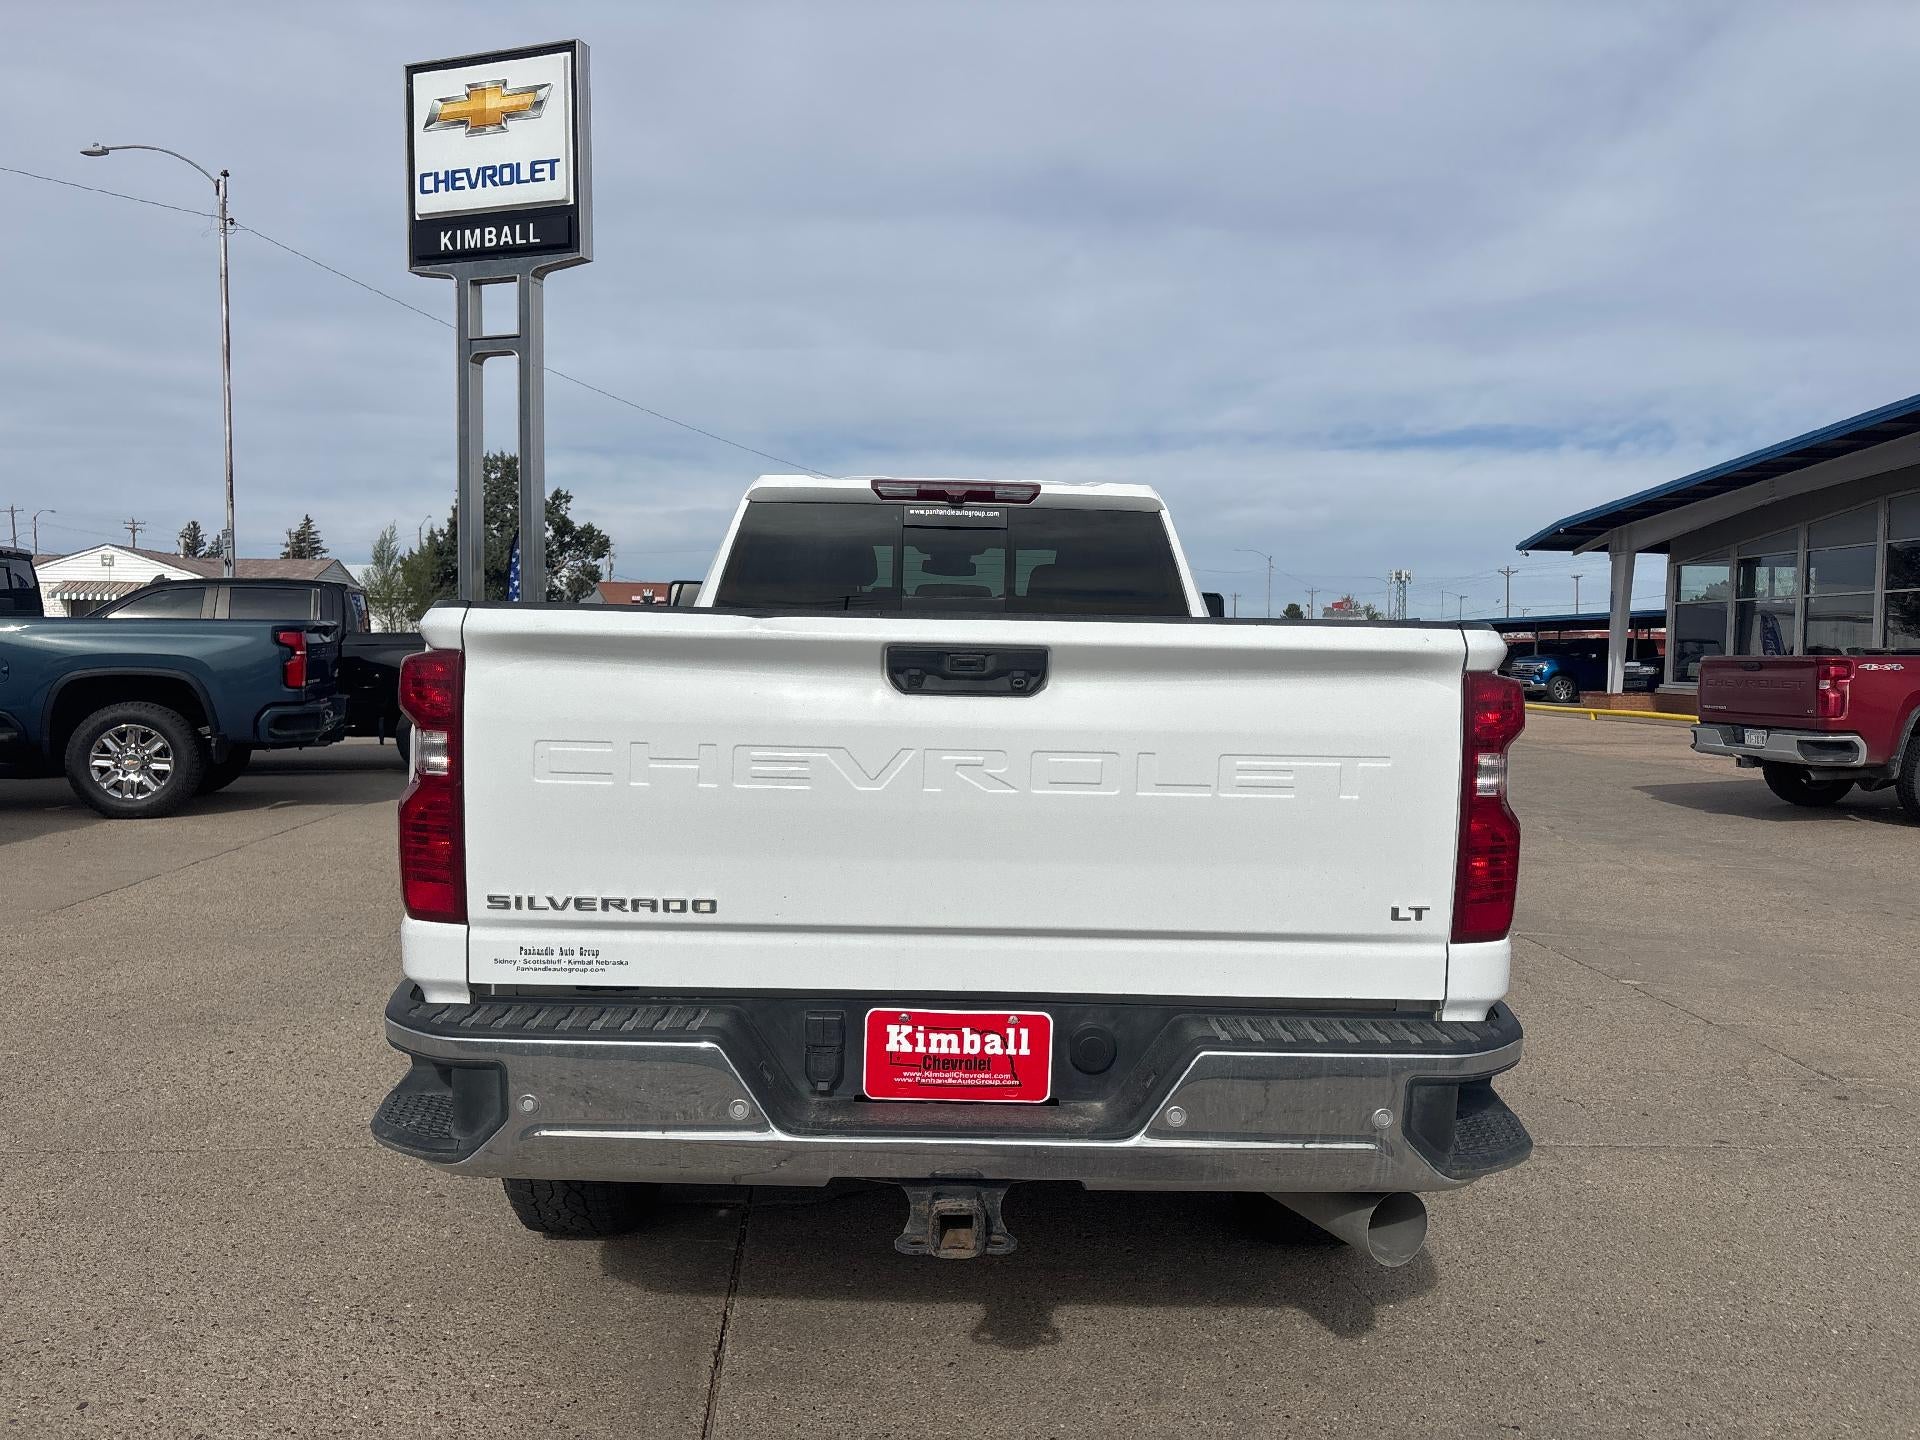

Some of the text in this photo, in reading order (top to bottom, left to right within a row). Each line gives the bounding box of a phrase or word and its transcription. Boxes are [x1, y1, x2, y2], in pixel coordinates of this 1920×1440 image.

[419, 158, 561, 194] CHEVROLET
[440, 222, 541, 251] KIMBALL
[533, 740, 1392, 801] CHEVROLET
[486, 893, 718, 914] SILVERADO
[1390, 905, 1431, 922] LT
[519, 946, 600, 958] Panhandle Auto Group
[493, 958, 518, 966] Sidney
[885, 1024, 1031, 1056] Kimball
[922, 1055, 992, 1071] Chevrolet
[902, 1070, 1011, 1080] www.KimballChevrolet.com
